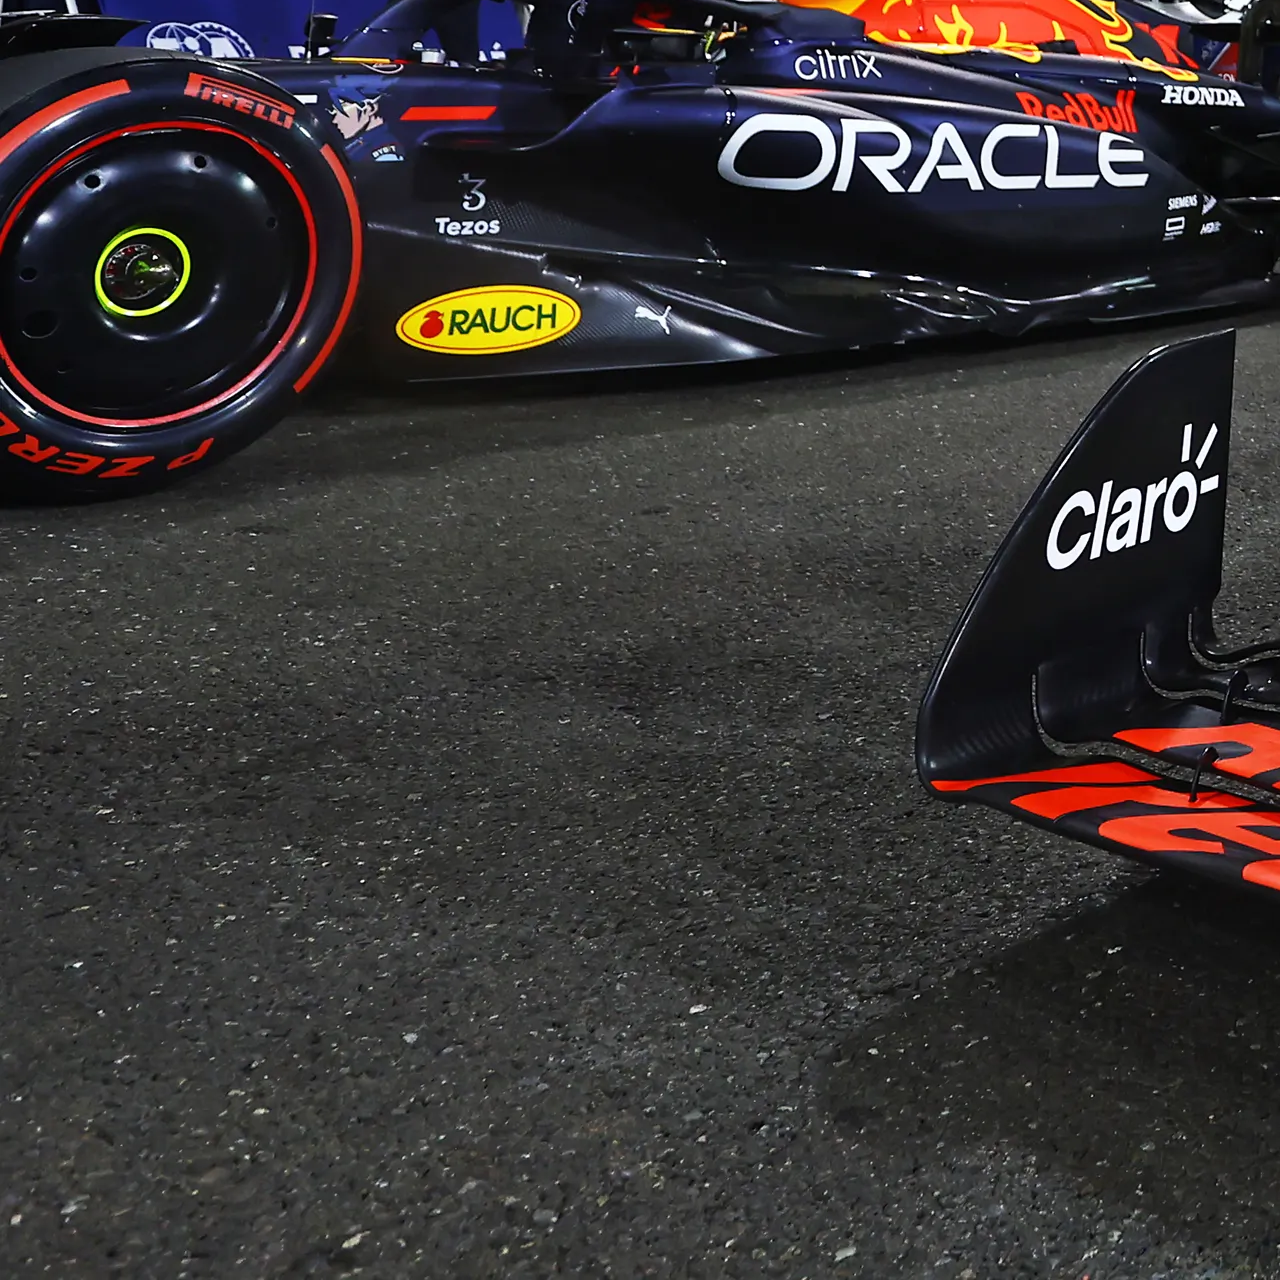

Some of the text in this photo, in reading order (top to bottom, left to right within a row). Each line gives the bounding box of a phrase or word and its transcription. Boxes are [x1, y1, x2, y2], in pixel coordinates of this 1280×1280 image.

[795, 49, 882, 80] citrix
[184, 72, 295, 129] PIRELLI
[1162, 84, 1245, 108] HONDA
[717, 113, 1150, 193] ORACLE
[435, 217, 501, 236] Tezos
[448, 303, 558, 336] RAUCH
